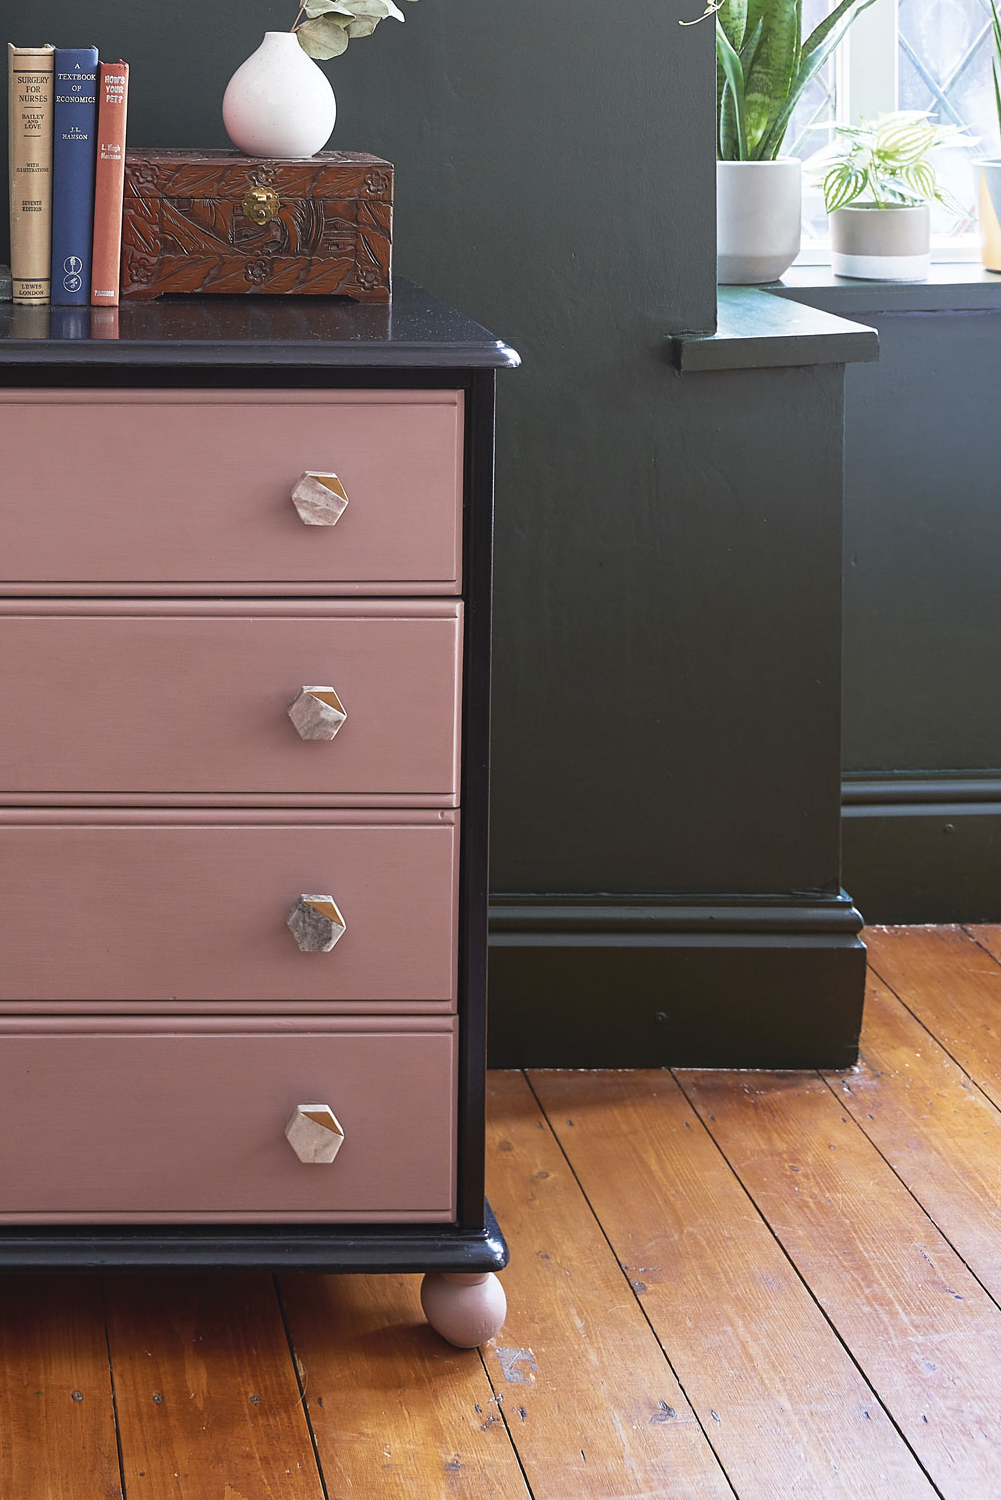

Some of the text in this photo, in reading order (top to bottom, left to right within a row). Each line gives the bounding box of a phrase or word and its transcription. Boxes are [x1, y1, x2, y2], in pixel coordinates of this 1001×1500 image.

[17, 76, 49, 84] SURGERY
[58, 73, 96, 81] TEXTBOOK
[26, 85, 41, 93] FOR
[71, 84, 82, 92] OF
[105, 85, 124, 93] YOUR
[19, 94, 48, 103] NURSES
[56, 95, 96, 103] ECONOMICS
[106, 95, 124, 104] PET?
